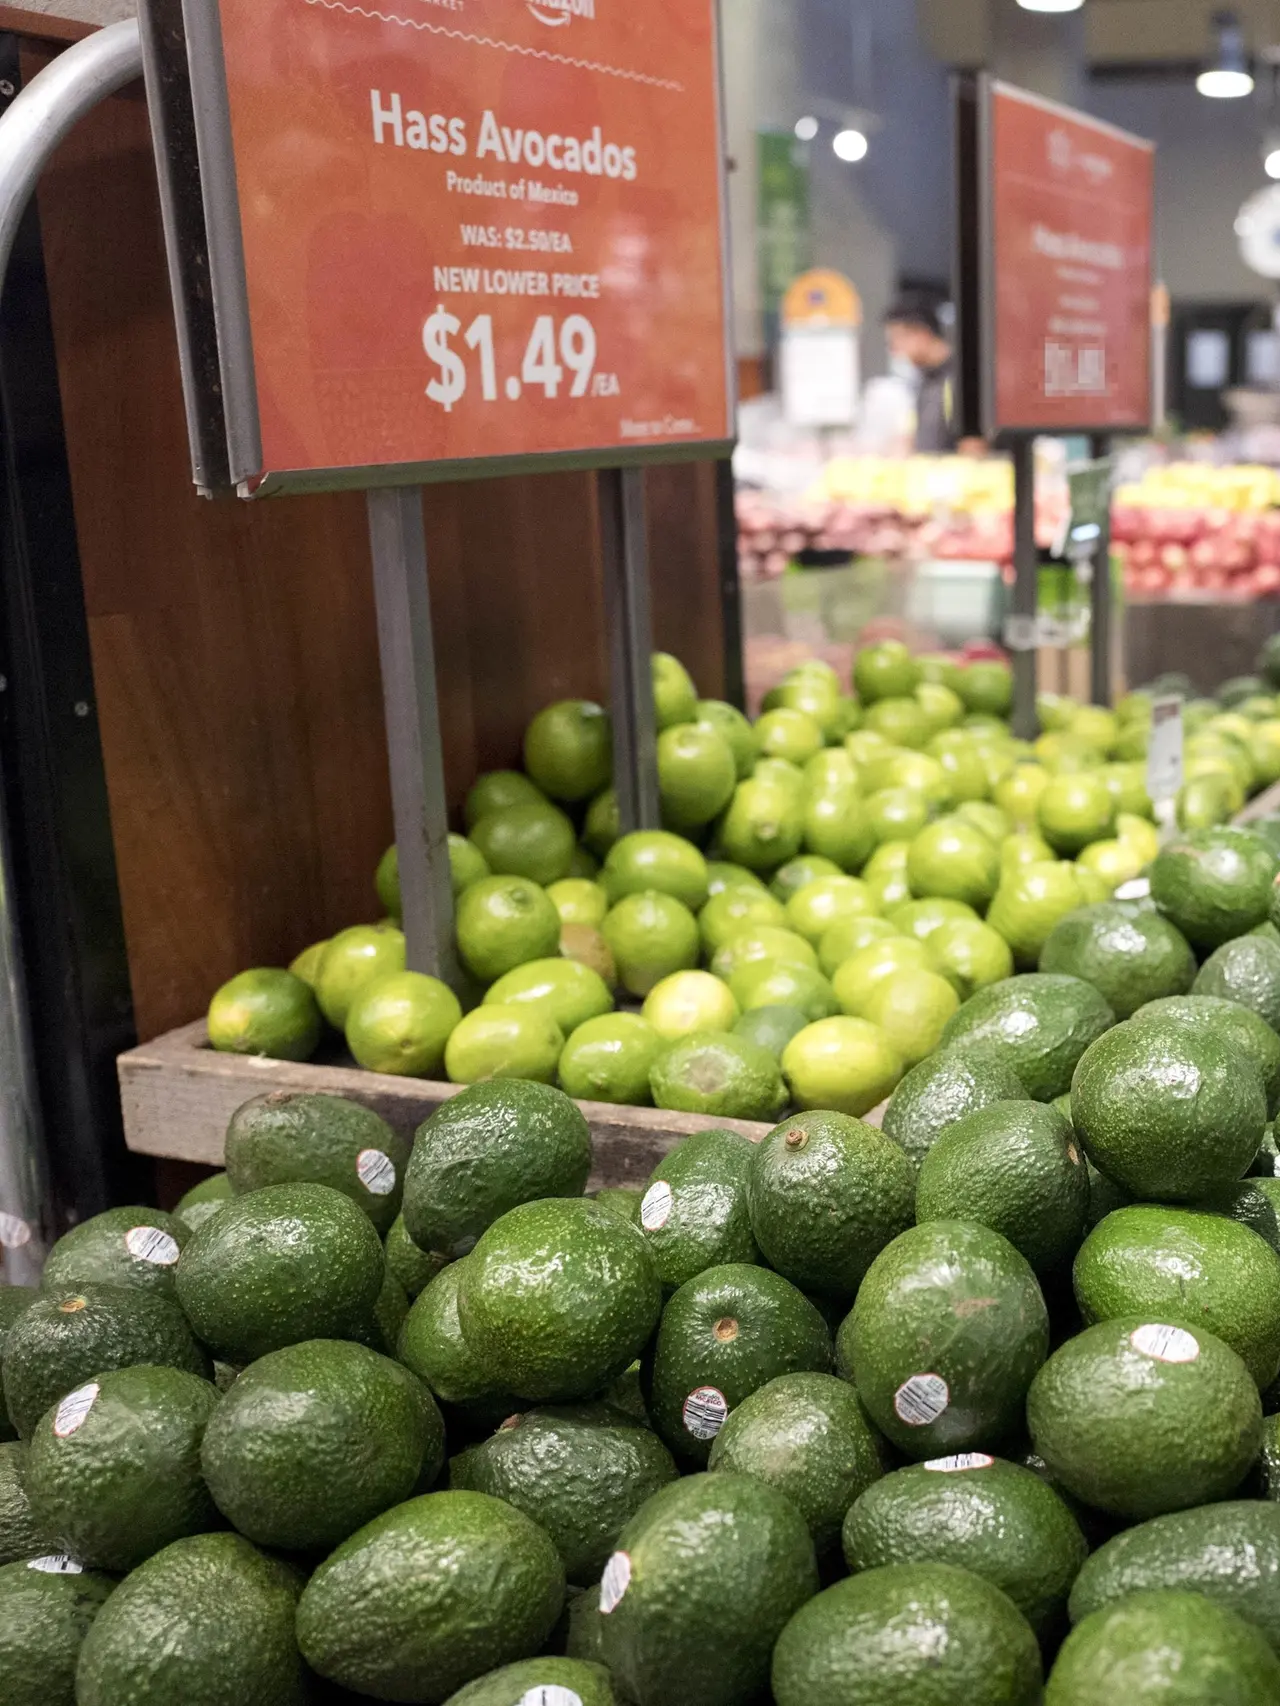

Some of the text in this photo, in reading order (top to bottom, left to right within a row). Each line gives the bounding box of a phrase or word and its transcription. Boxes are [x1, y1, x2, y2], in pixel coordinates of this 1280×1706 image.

[370, 88, 638, 181] Hass Avocados
[446, 170, 579, 206] Product of Mexico
[460, 224, 502, 247] WAS:
[433, 265, 600, 298] NEW LOWER PRICE
